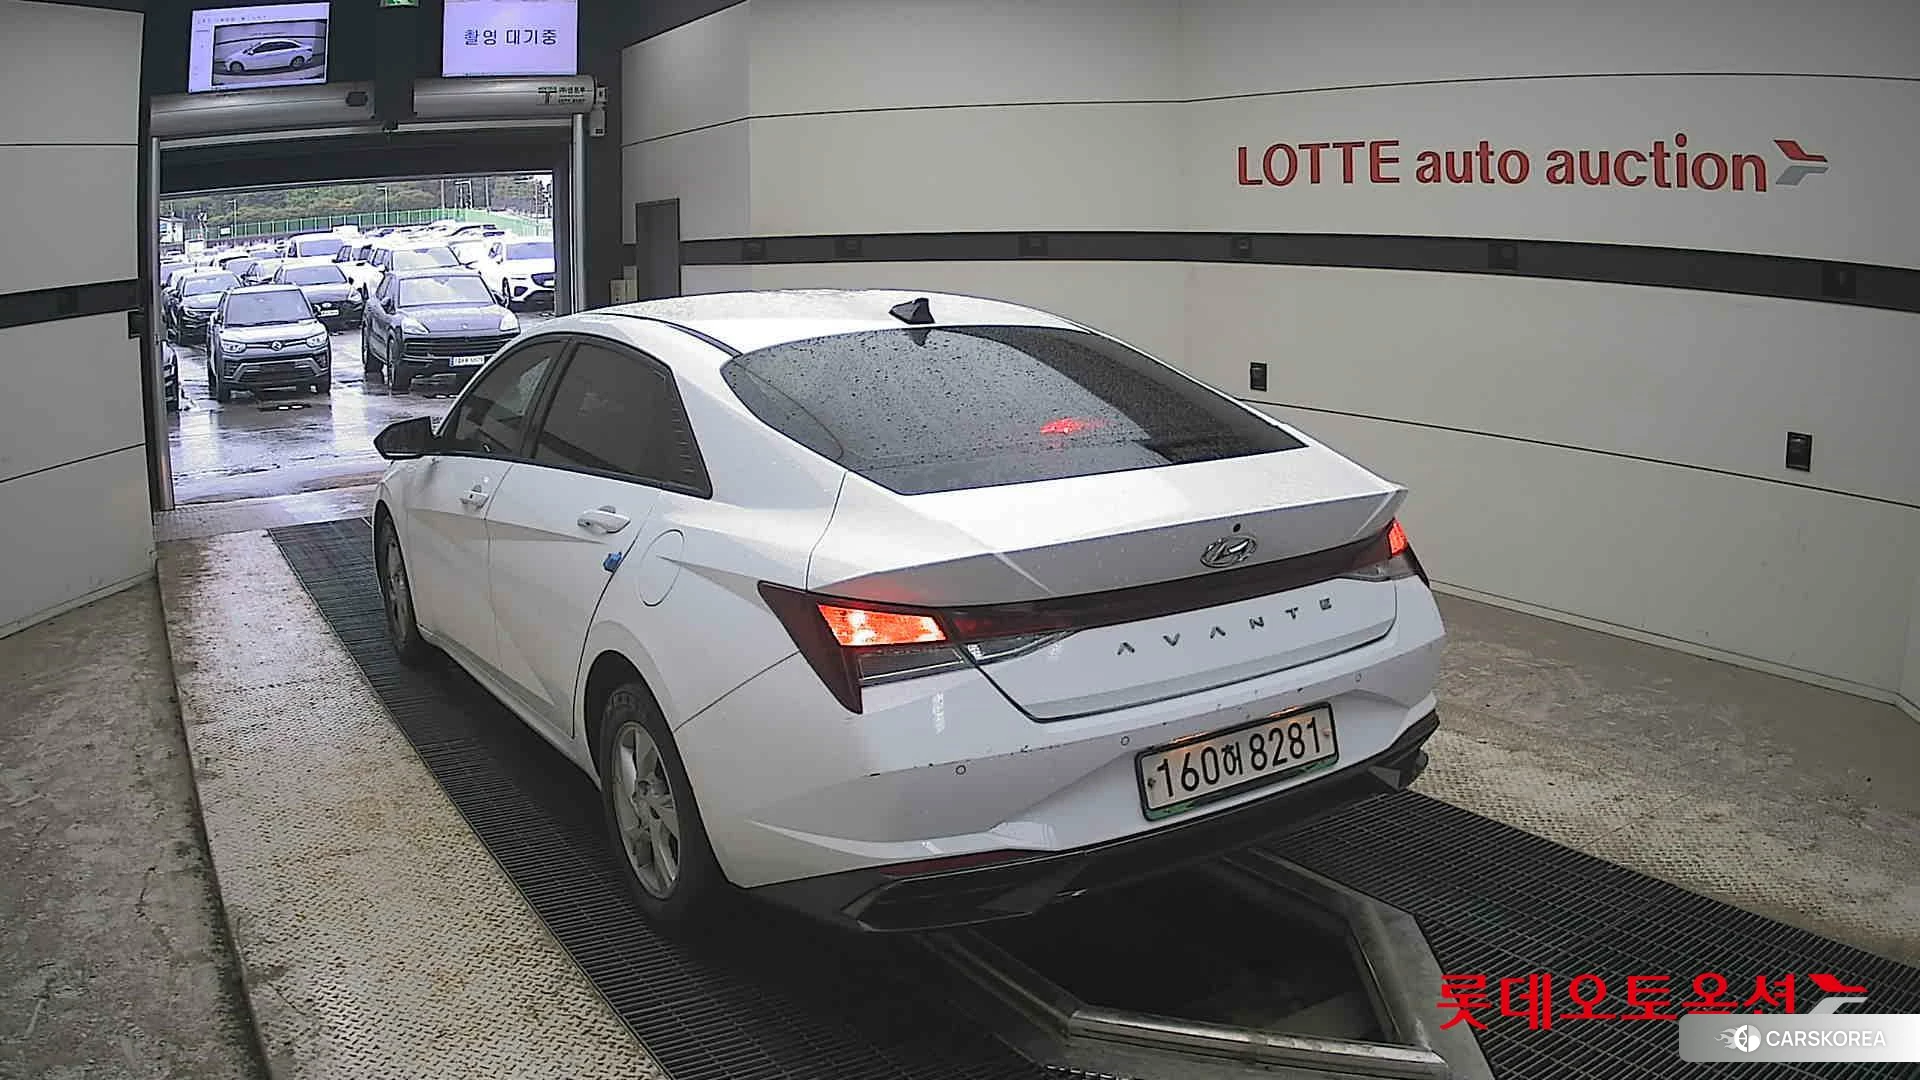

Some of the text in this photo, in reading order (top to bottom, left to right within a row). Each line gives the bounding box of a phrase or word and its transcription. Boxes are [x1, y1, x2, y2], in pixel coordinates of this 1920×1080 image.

[506, 29, 557, 46] 대기중
[1237, 132, 1768, 193] LOTTE auto auction
[1117, 597, 1333, 656] AVANTE
